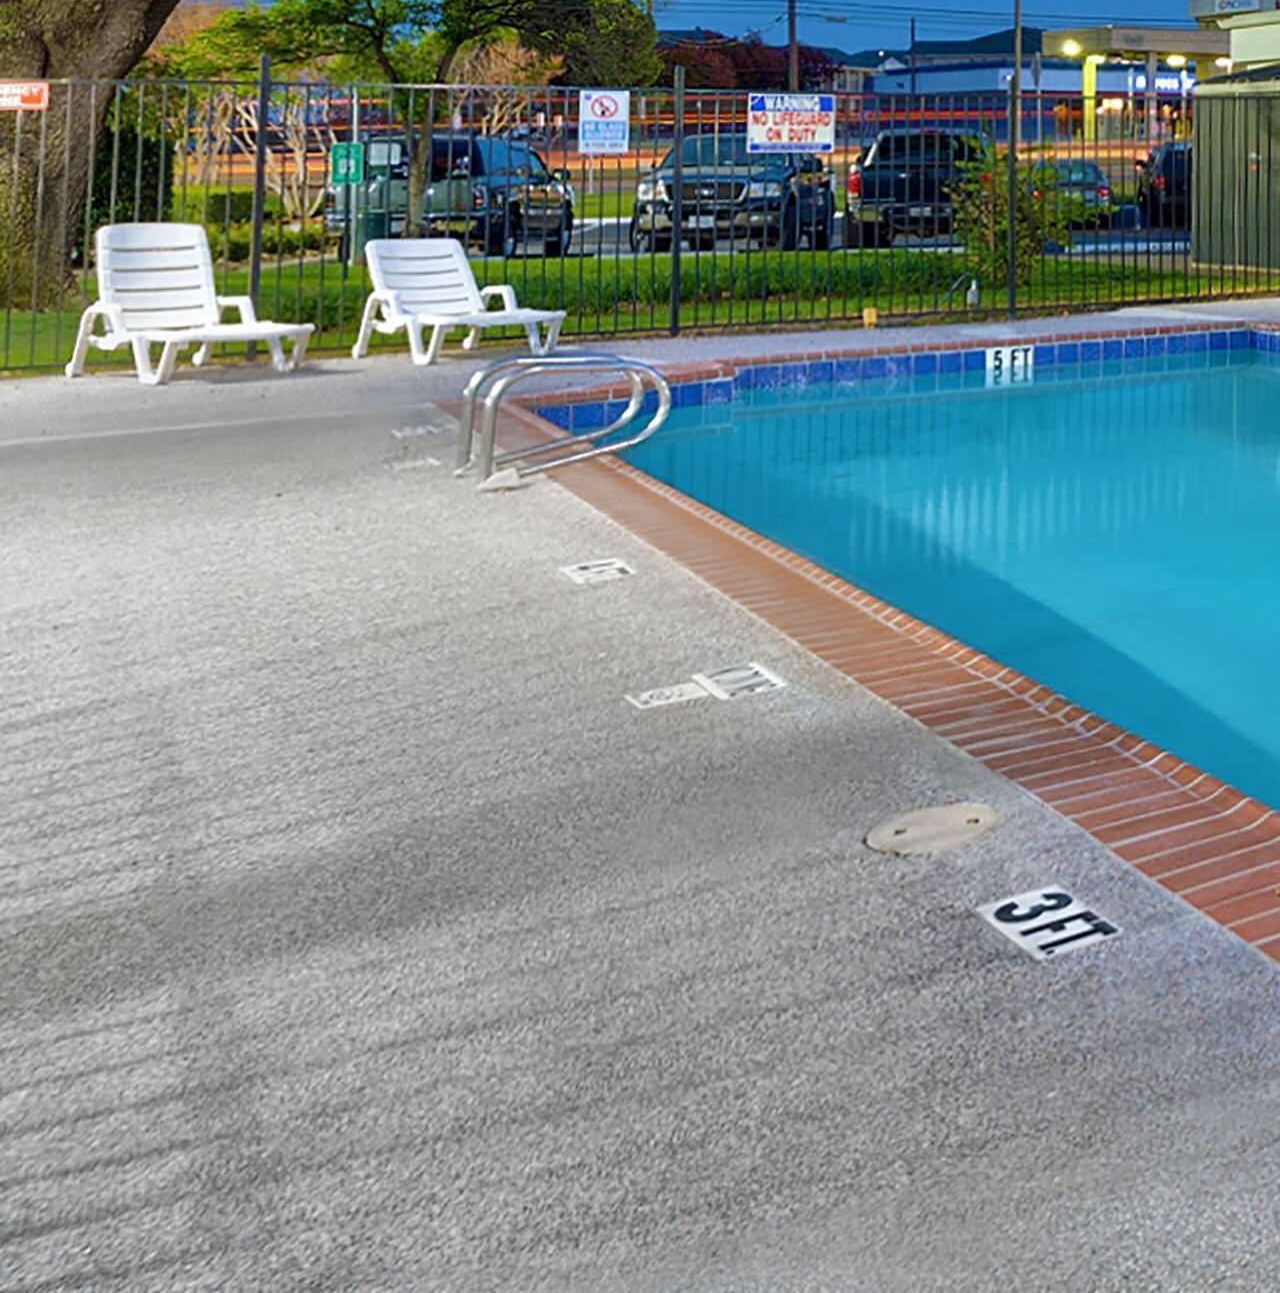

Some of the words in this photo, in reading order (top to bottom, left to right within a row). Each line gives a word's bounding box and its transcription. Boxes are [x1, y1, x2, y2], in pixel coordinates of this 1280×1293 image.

[765, 95, 819, 112] WARNING
[752, 112, 769, 126] NO
[773, 112, 831, 127] LIFEGUARD
[766, 127, 782, 141] ON
[788, 128, 816, 142] DUTY
[993, 349, 1003, 370] 5
[1011, 347, 1031, 369] FT
